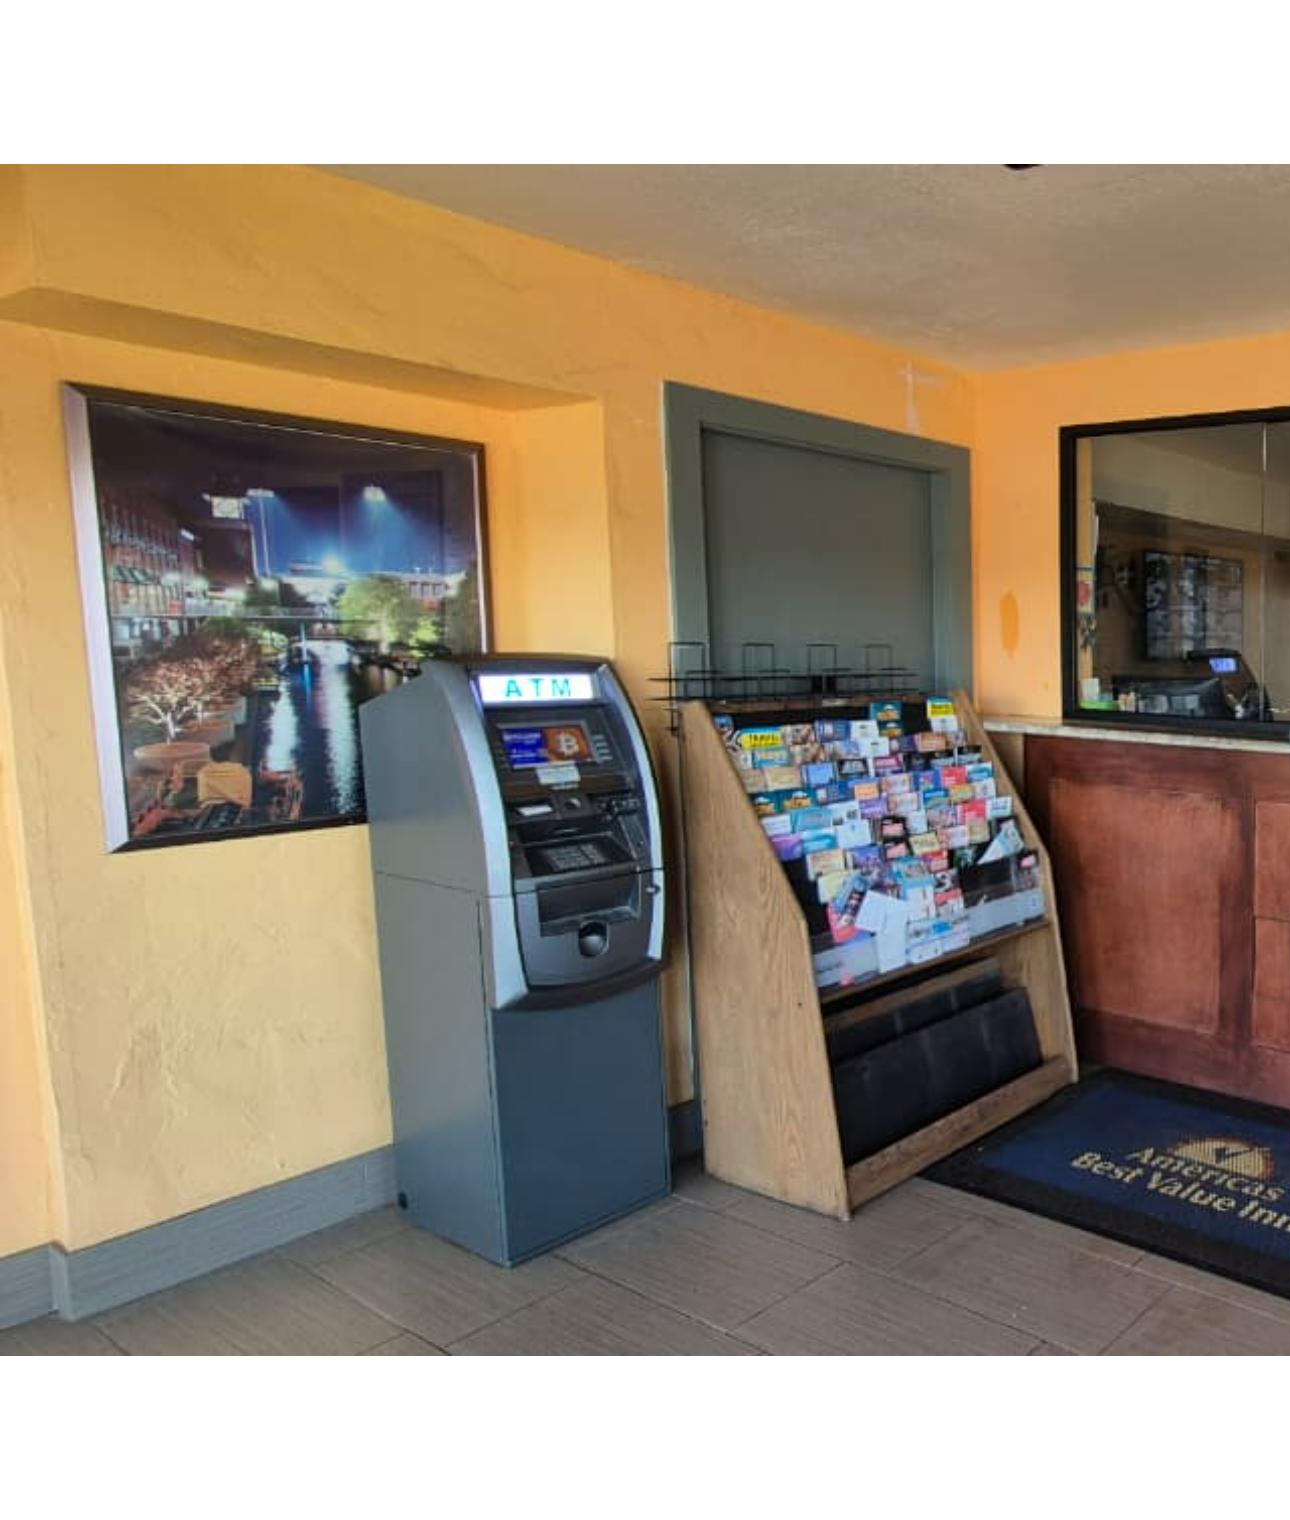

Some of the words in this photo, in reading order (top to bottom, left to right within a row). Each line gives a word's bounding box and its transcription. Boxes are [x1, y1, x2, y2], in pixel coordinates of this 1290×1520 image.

[504, 678, 572, 698] ATM
[1071, 1151, 1144, 1184] Best
[1147, 1171, 1236, 1212] Value
[1126, 1148, 1285, 1201] Americas
